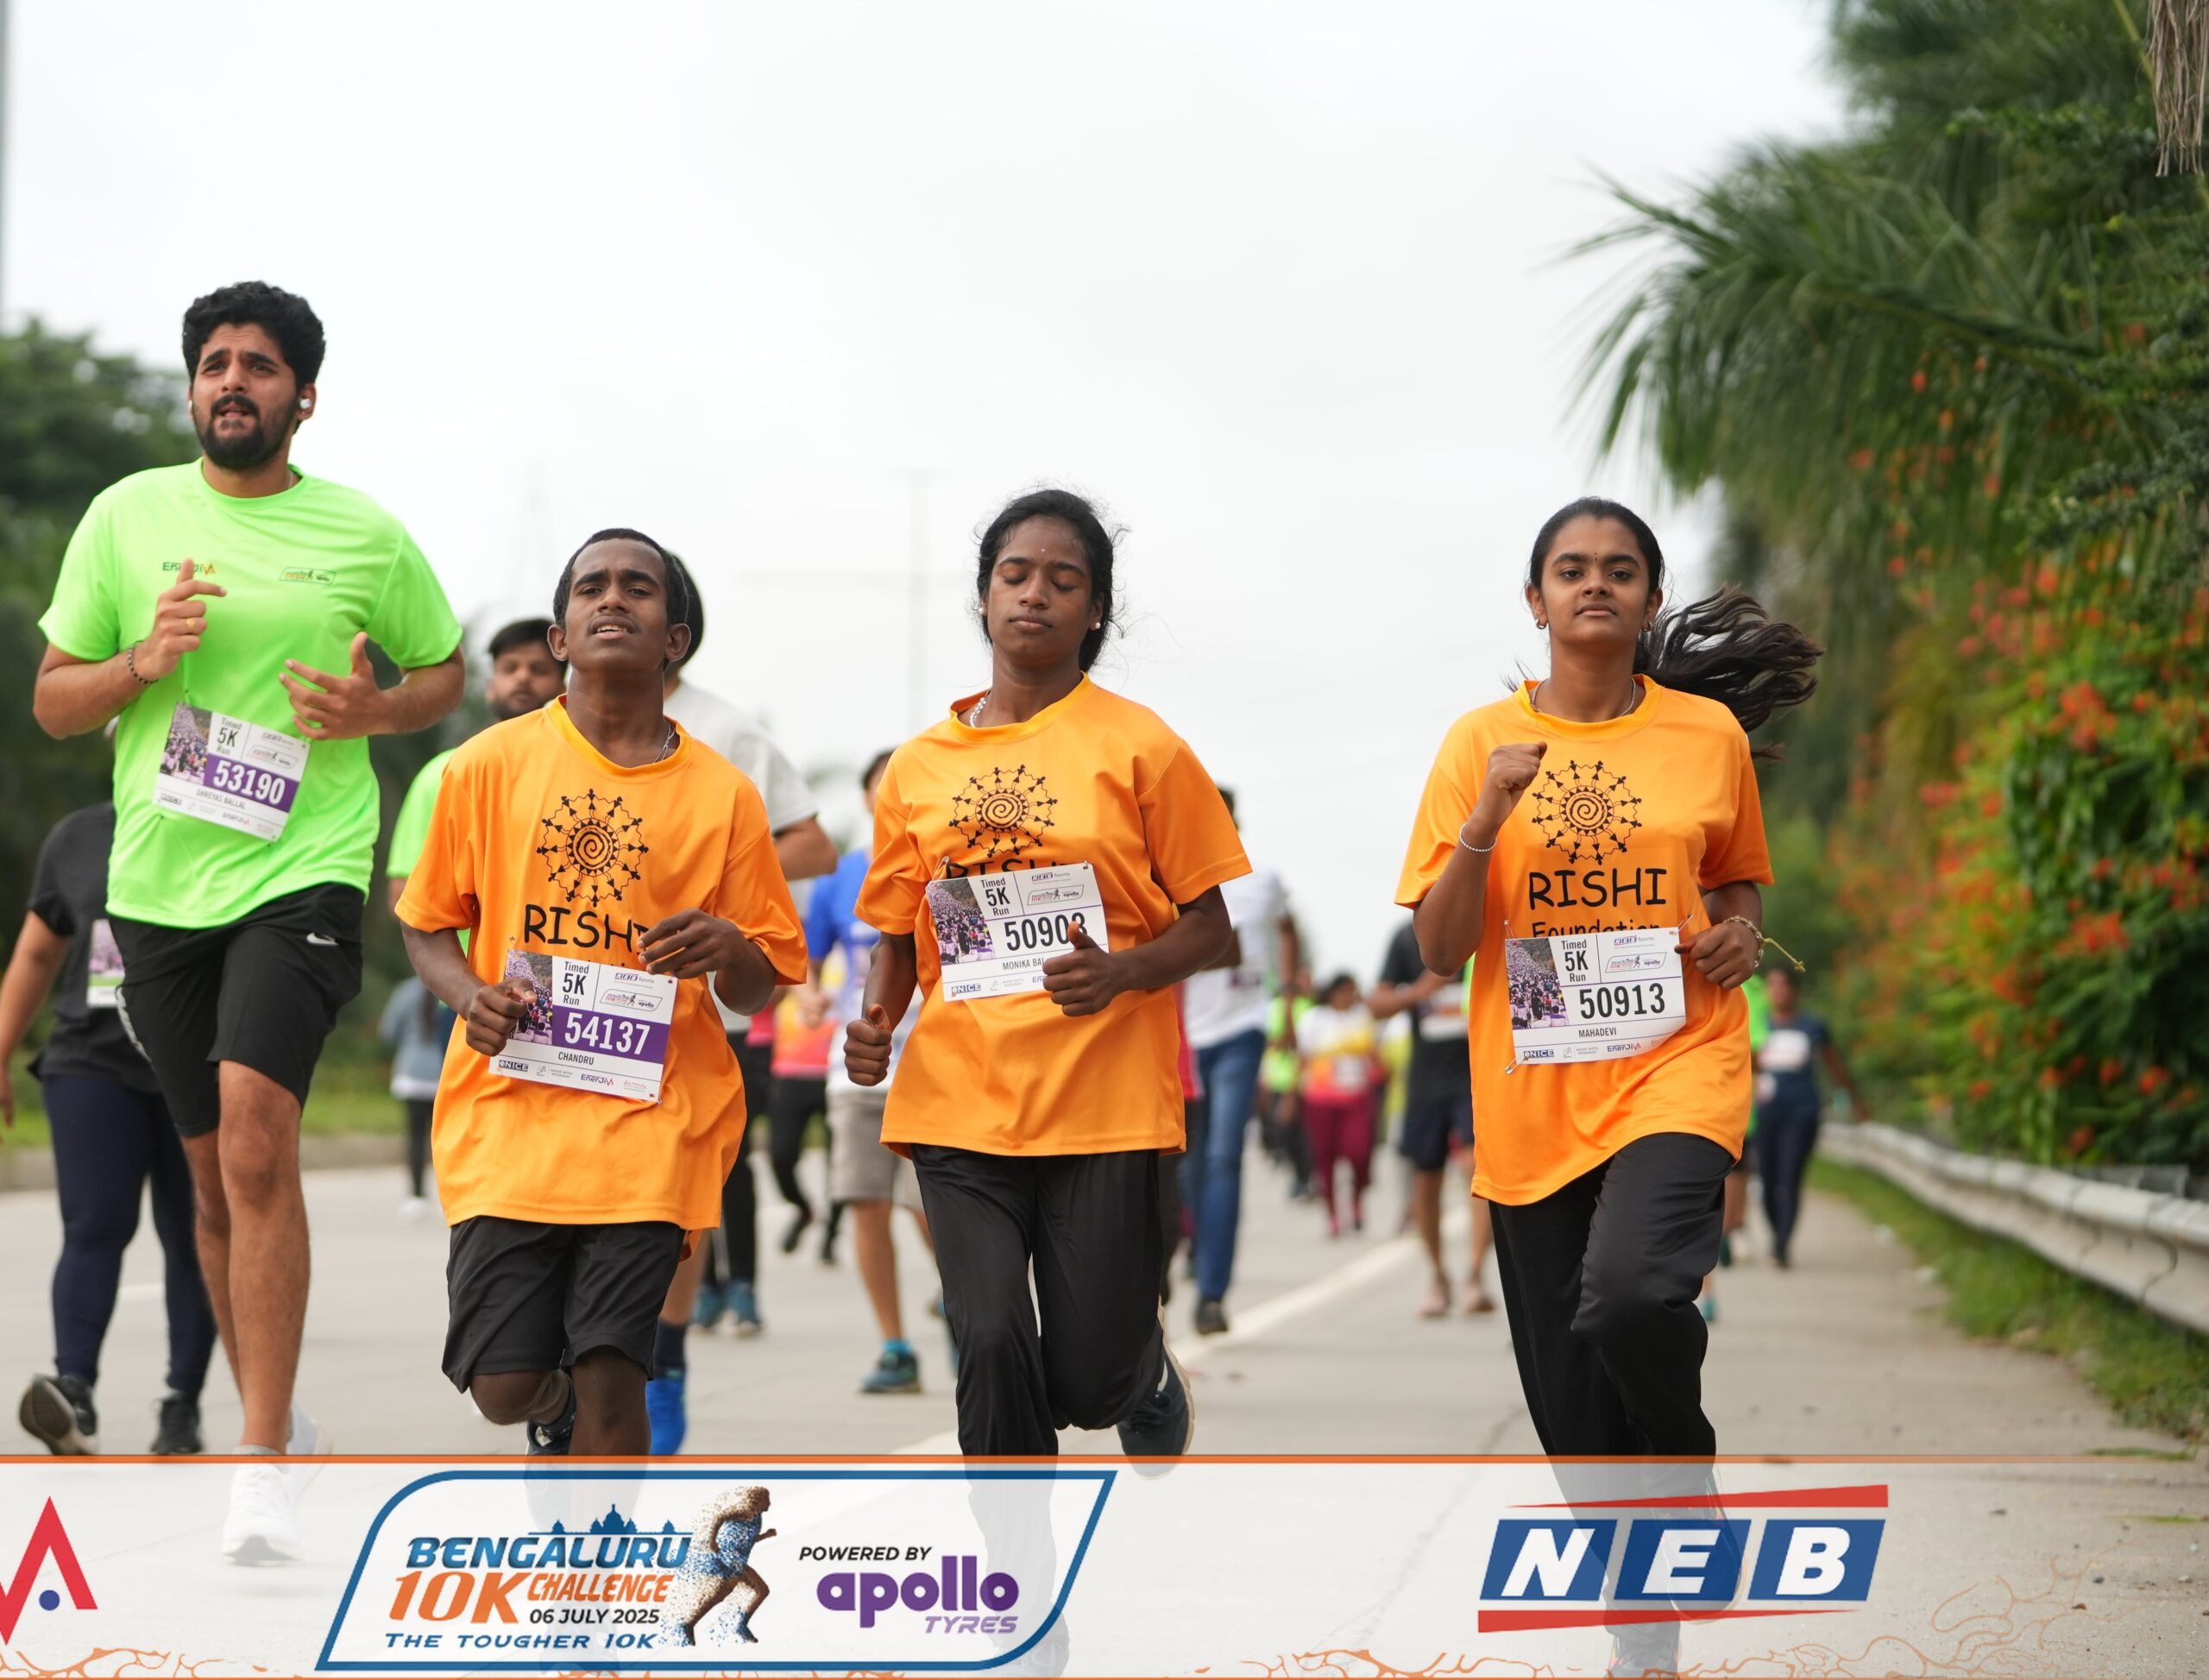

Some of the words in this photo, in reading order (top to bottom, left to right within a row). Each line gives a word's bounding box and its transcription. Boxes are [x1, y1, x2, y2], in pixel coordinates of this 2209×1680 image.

[222, 717, 242, 730] Timed
[217, 727, 238, 747] 5K
[217, 744, 230, 755] Run
[213, 759, 286, 805] 53190
[196, 788, 223, 802] SHREYAS
[223, 795, 246, 809] BALLAL
[980, 877, 1006, 888] Timed
[1528, 867, 1667, 910] RISHI
[985, 886, 1010, 907] 5K
[992, 907, 1010, 916] Run
[1561, 940, 1588, 951] Timed
[564, 960, 590, 974] Timed
[1002, 959, 1031, 971] MONIKA
[1032, 958, 1044, 966] BA
[1564, 950, 1589, 972] 5K
[562, 972, 587, 996] 5K
[1569, 972, 1587, 983] Run
[563, 994, 580, 1006] Run
[1579, 983, 1665, 1020] 50913
[564, 1011, 651, 1055] 54137
[1578, 1027, 1617, 1038] MAHADEVI
[557, 1051, 595, 1066] CHANDRU
[1530, 1048, 1554, 1059] NICE
[506, 1060, 529, 1072] NICE
